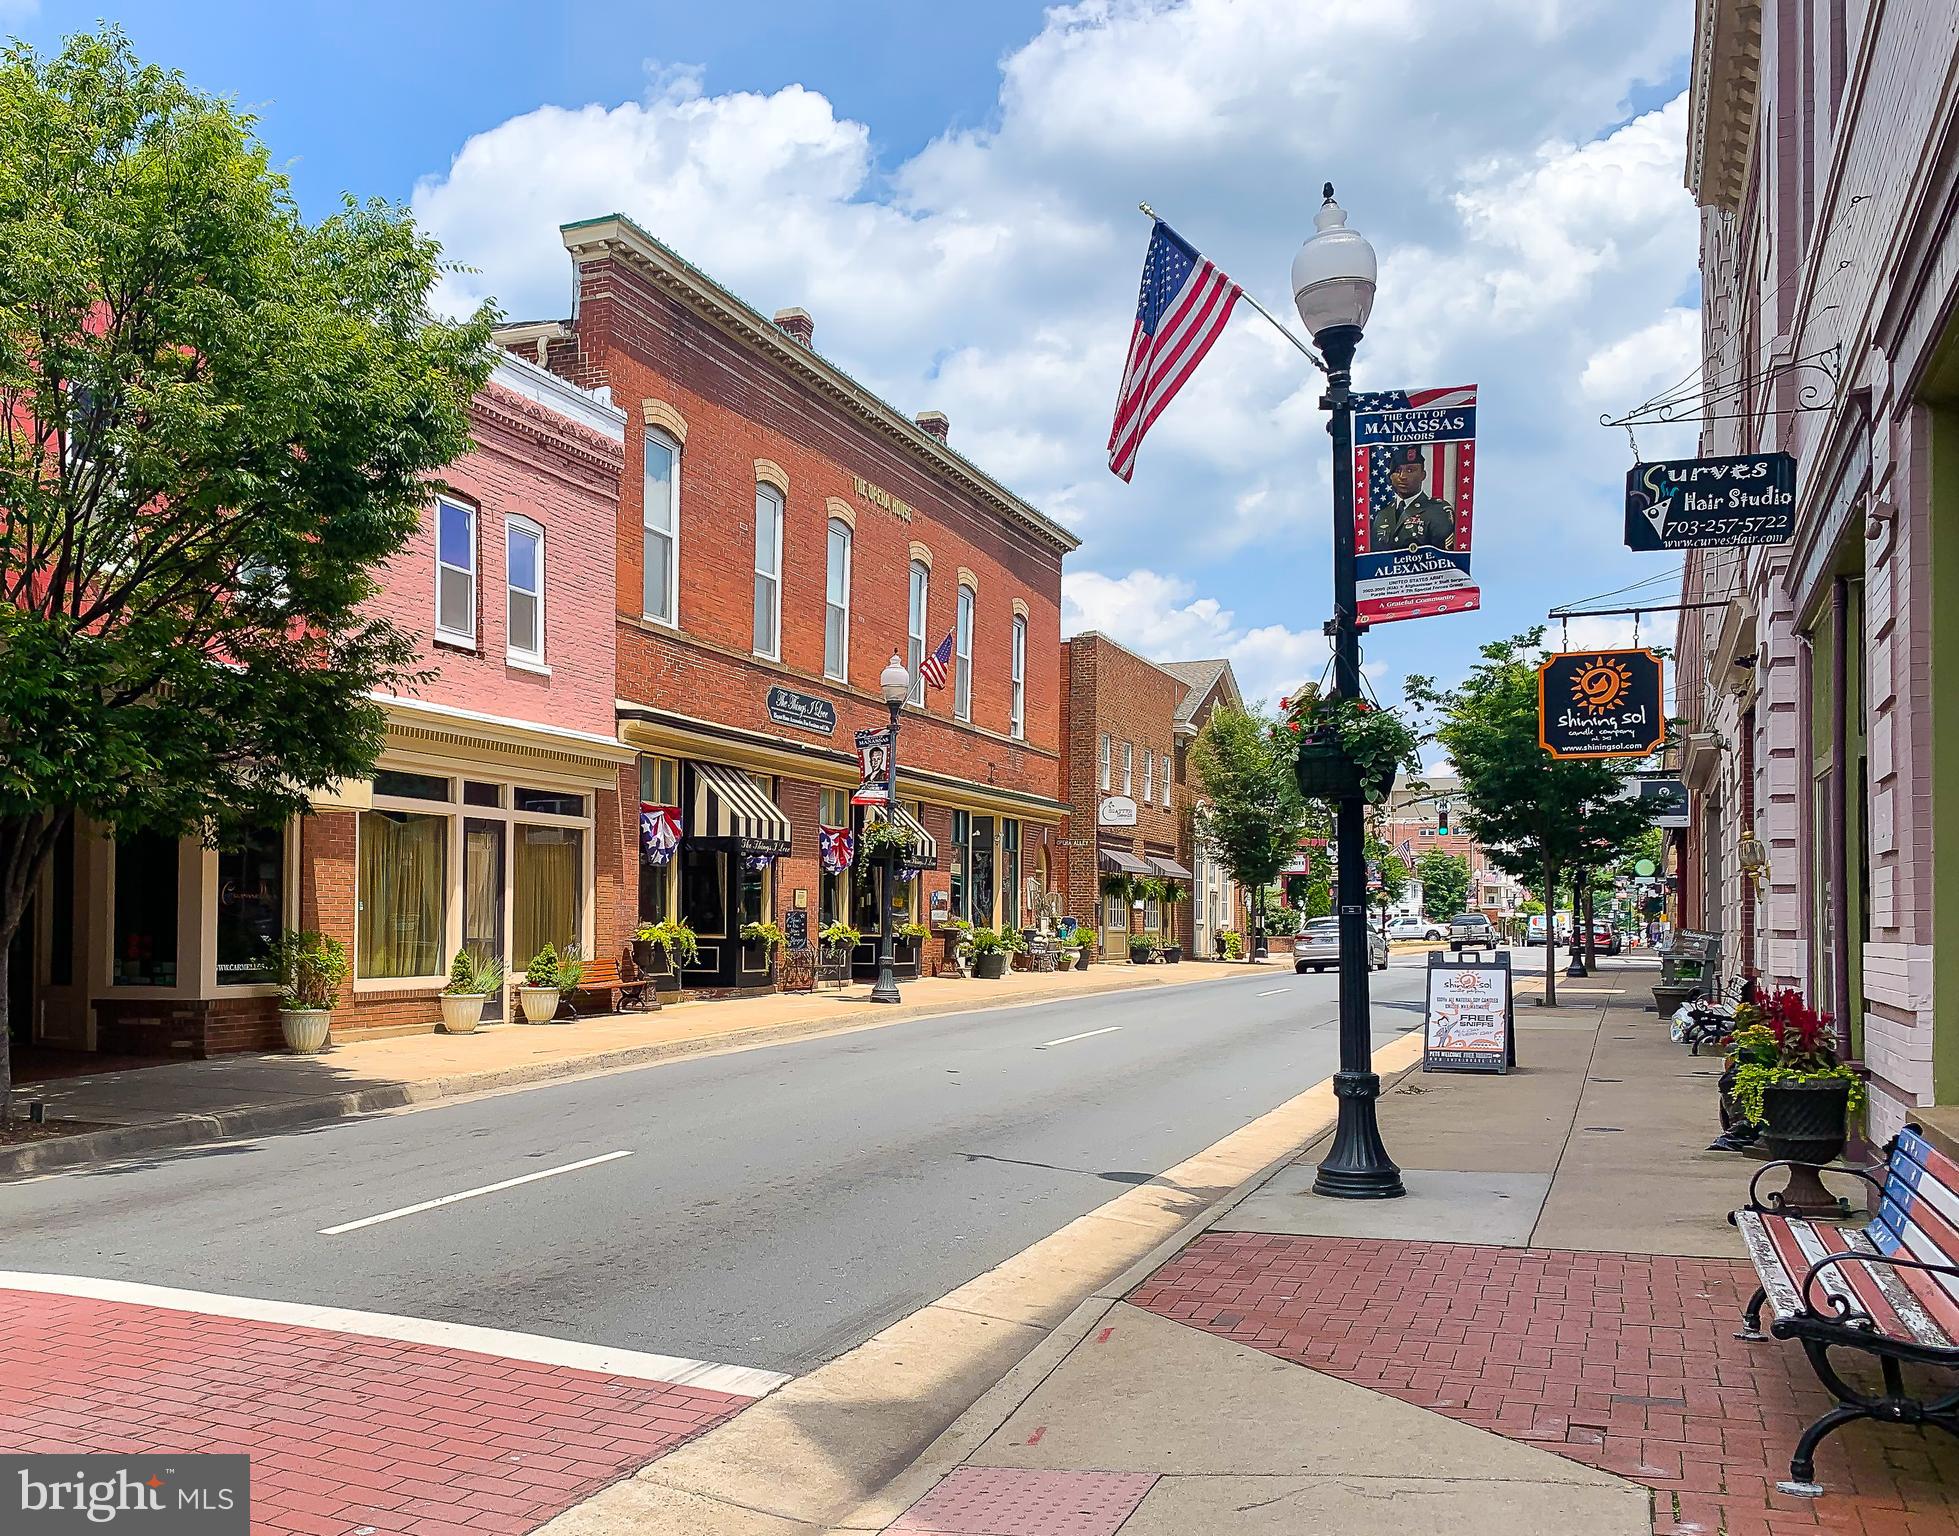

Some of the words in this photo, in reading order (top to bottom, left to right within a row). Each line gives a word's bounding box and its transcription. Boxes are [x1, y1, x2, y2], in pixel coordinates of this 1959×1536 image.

[1383, 413, 1402, 422] THE
[1405, 411, 1429, 420] CITY
[1432, 410, 1446, 418] OF
[1365, 417, 1465, 435] MANASSAS
[1392, 432, 1435, 442] HONORS
[1684, 491, 1724, 512] Hair
[1728, 485, 1792, 508] Studio
[1665, 515, 1788, 537] 703-257-5722
[1662, 533, 1783, 549] www.curvesHair.com
[1393, 554, 1422, 564] LeRoy
[1425, 551, 1435, 560] E.
[1374, 558, 1457, 577] ALEXANDER
[1388, 578, 1408, 586] UNITED
[1408, 576, 1429, 584] STATES
[1386, 599, 1414, 608] Grateful
[1415, 594, 1457, 604] Community
[1557, 708, 1618, 729] shining
[1621, 704, 1646, 725] sol
[1568, 727, 1594, 736] candle
[1598, 729, 1635, 738] company
[1562, 742, 1642, 752] www.shiningsol.com
[741, 839, 752, 849] The
[753, 840, 771, 853] Things
[1478, 978, 1492, 989] sol
[1460, 1014, 1494, 1022] FREE
